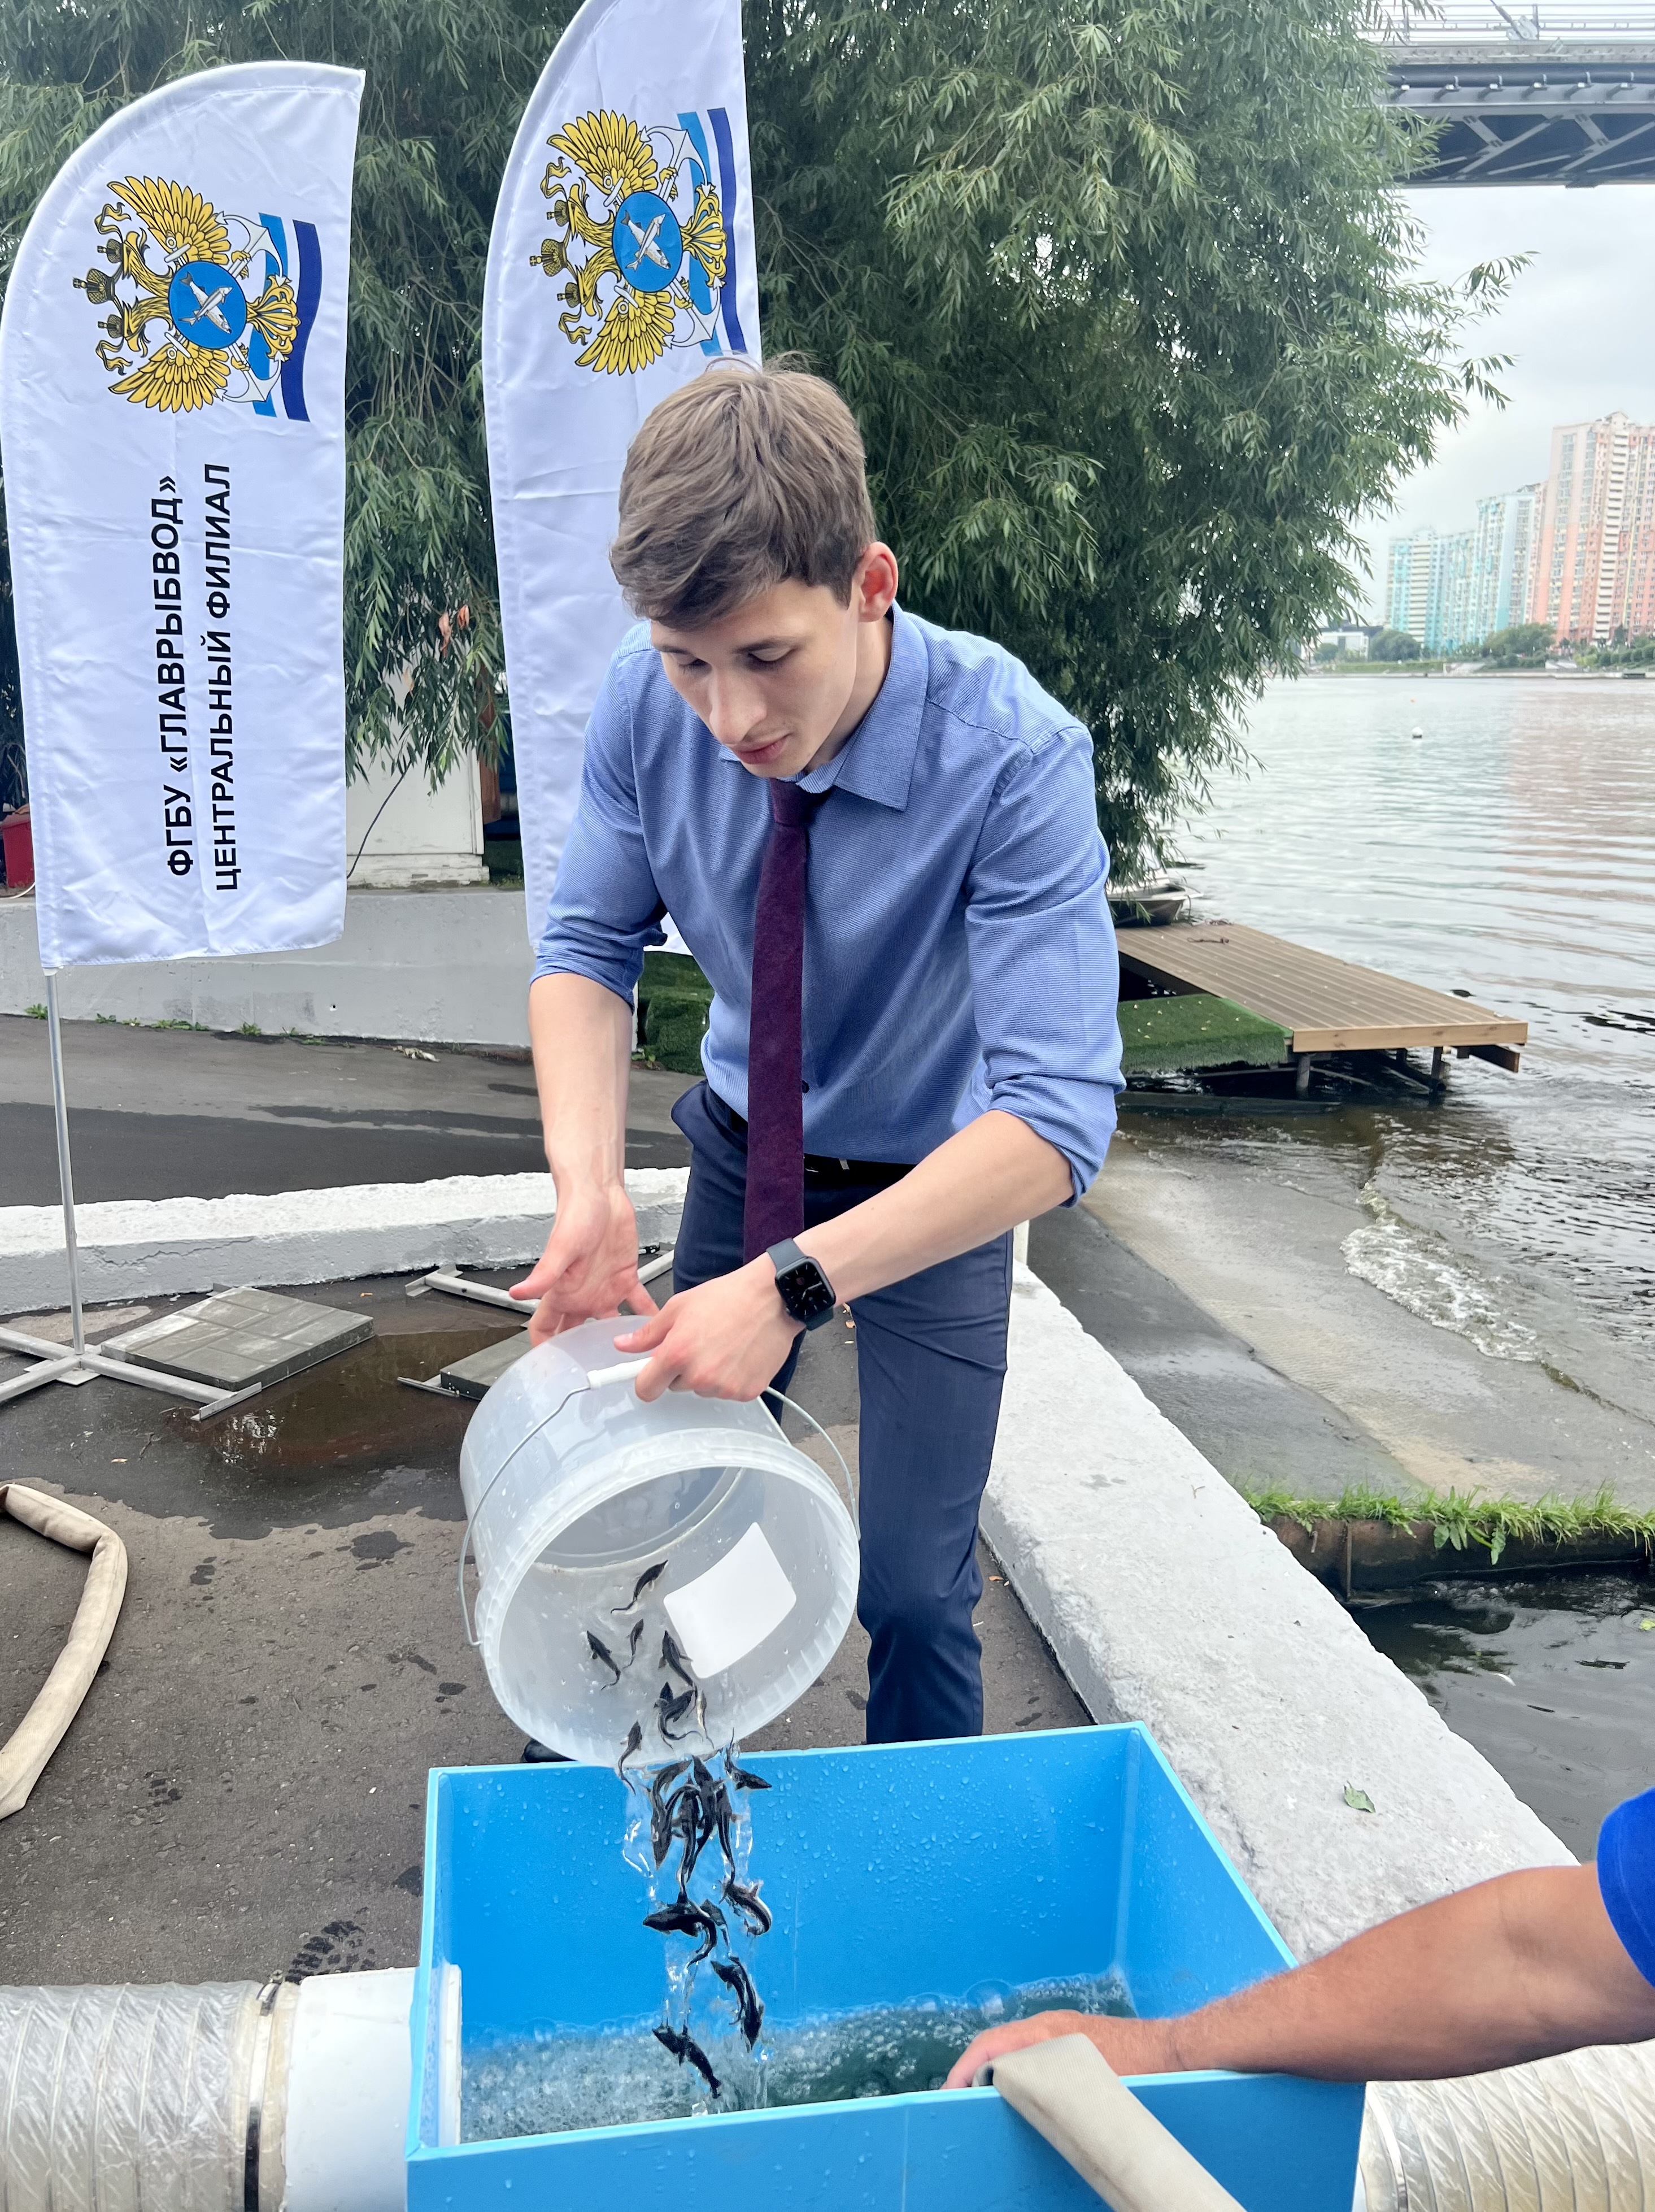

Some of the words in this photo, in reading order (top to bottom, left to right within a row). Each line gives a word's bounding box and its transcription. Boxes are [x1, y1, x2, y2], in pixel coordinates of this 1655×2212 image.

[151, 475, 188, 773] «ГЛАВРЫБВОД»
[204, 463, 231, 619] ФИЛИАЛ
[163, 784, 194, 876] ФГБУ
[200, 630, 242, 891] ЦЕНТРАЛЬНЫЙ
